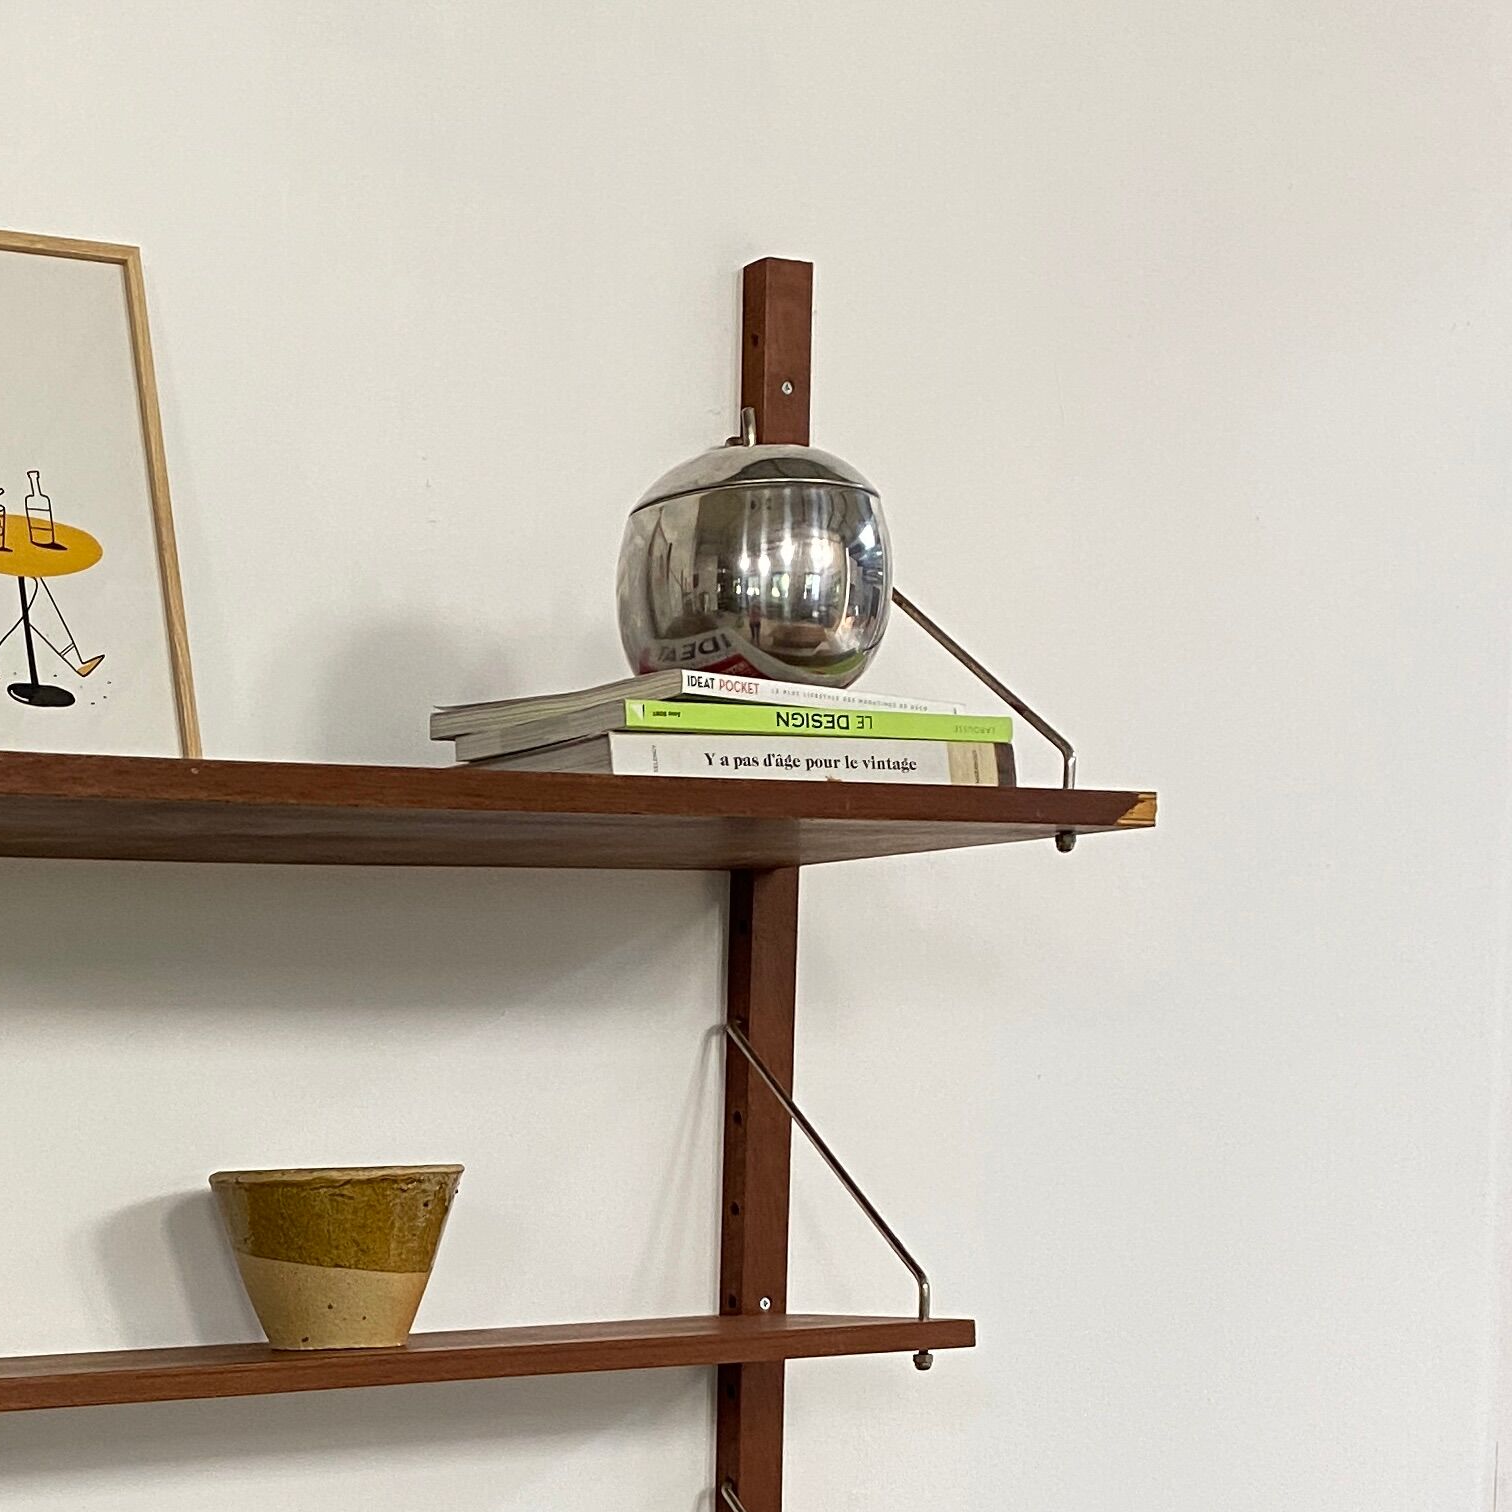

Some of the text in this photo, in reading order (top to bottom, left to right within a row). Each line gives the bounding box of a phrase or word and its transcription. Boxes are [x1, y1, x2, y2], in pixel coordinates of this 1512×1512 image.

[687, 675, 760, 695] IDEAT POCKET
[776, 711, 873, 730] LE DESIGN
[704, 753, 918, 773] Y a pas d'âge pour le vintage
